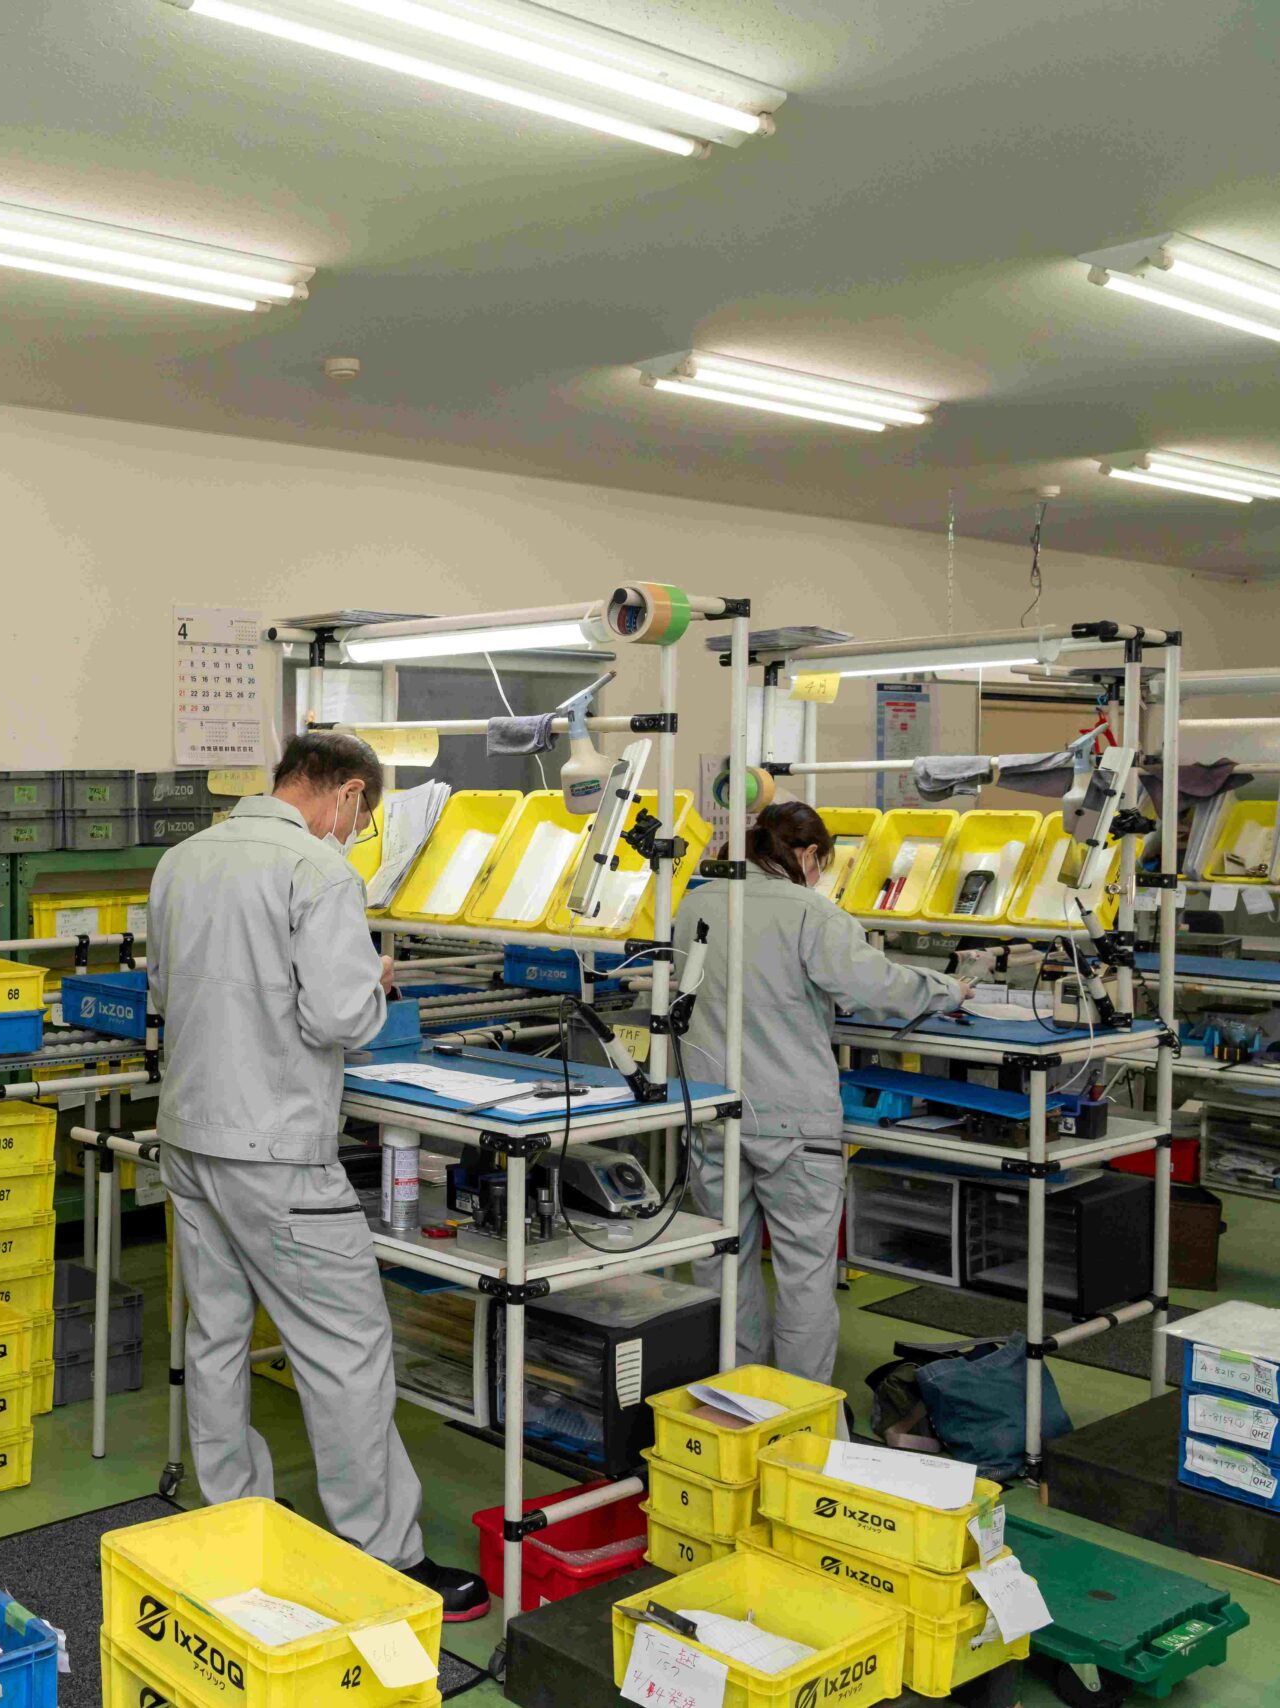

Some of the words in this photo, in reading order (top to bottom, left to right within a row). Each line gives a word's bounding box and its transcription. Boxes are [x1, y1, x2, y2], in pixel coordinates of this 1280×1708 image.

[178, 623, 188, 640] 4
[167, 821, 195, 832] IxZOQ
[7, 988, 19, 1000] 68
[98, 1001, 134, 1019] IxZOQ
[619, 1028, 641, 1041] TMF
[0, 1189, 11, 1201] 87
[0, 1291, 11, 1303] 76
[1255, 1383, 1272, 1396] QHZ
[1251, 1428, 1269, 1440] QHZ
[685, 1437, 702, 1456] 48
[1252, 1476, 1273, 1489] QHZ
[680, 1490, 689, 1506] 6
[843, 1506, 896, 1532] IxZOQ
[678, 1542, 694, 1562] 70
[845, 1566, 895, 1594] IxZOQ
[174, 1619, 245, 1691] IxZOQ
[341, 1665, 363, 1690] 42
[823, 1654, 877, 1698] IxZOQ
